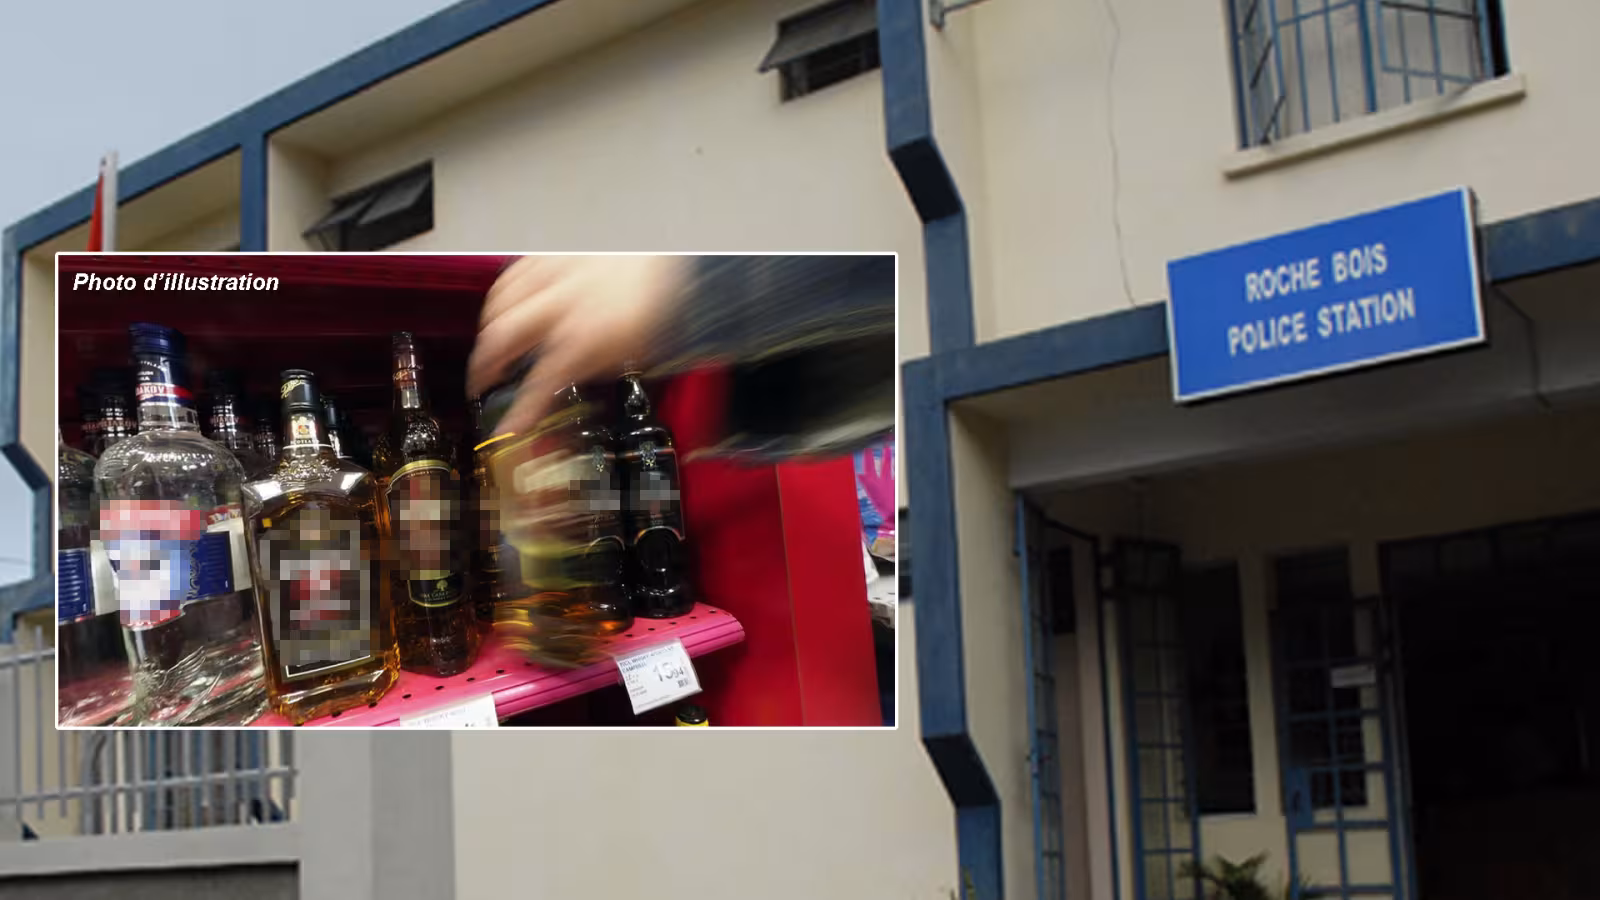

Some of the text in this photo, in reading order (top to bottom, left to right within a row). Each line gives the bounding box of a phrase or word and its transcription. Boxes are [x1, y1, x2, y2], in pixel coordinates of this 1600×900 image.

[1245, 243, 1388, 302] ROCHE BOIS
[1227, 287, 1416, 357] POLICE STATION
